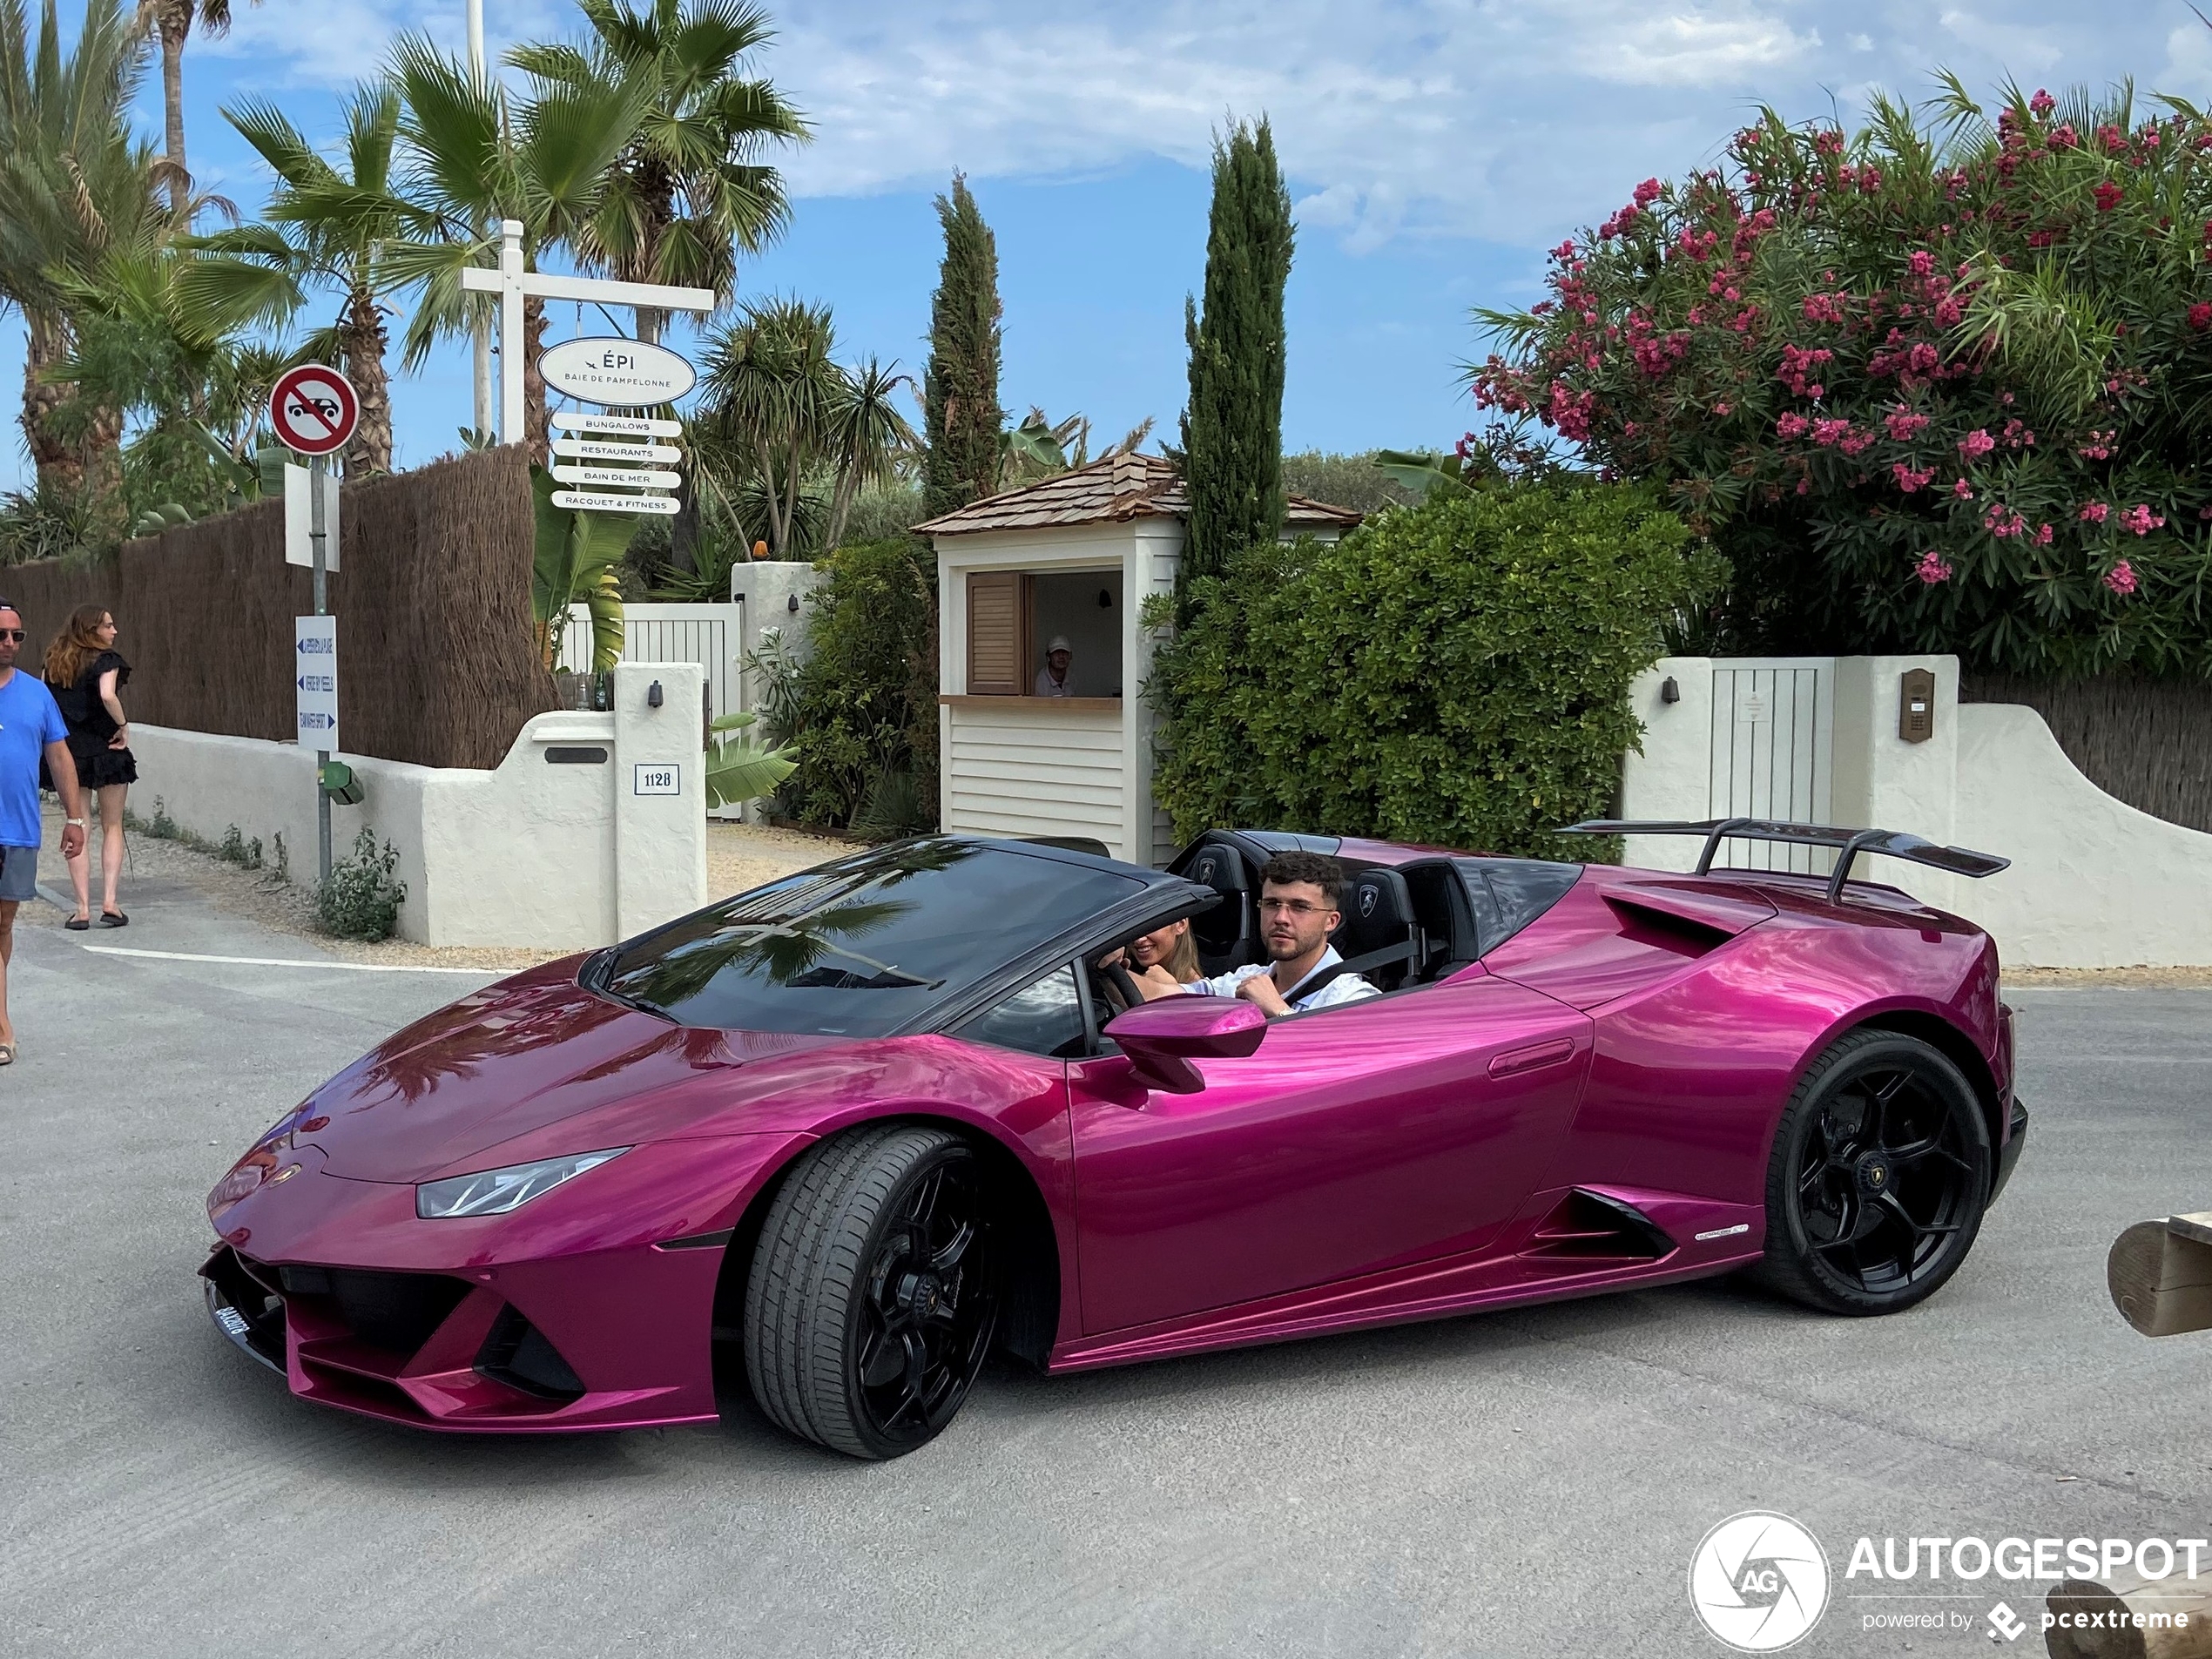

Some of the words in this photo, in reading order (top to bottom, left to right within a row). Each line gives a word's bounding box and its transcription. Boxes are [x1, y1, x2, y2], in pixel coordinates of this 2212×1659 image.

[604, 350, 634, 369] ÉPI
[564, 373, 588, 381] BAIE
[590, 374, 604, 383] DE
[606, 376, 671, 388] PAMPELONNE
[585, 421, 651, 431] BUNGALOWS
[581, 446, 653, 457] RESTAURANTS
[584, 472, 609, 481] BAIN
[565, 496, 614, 506] RACQUET
[625, 501, 667, 509] FITNESS
[644, 772, 671, 786] 1128
